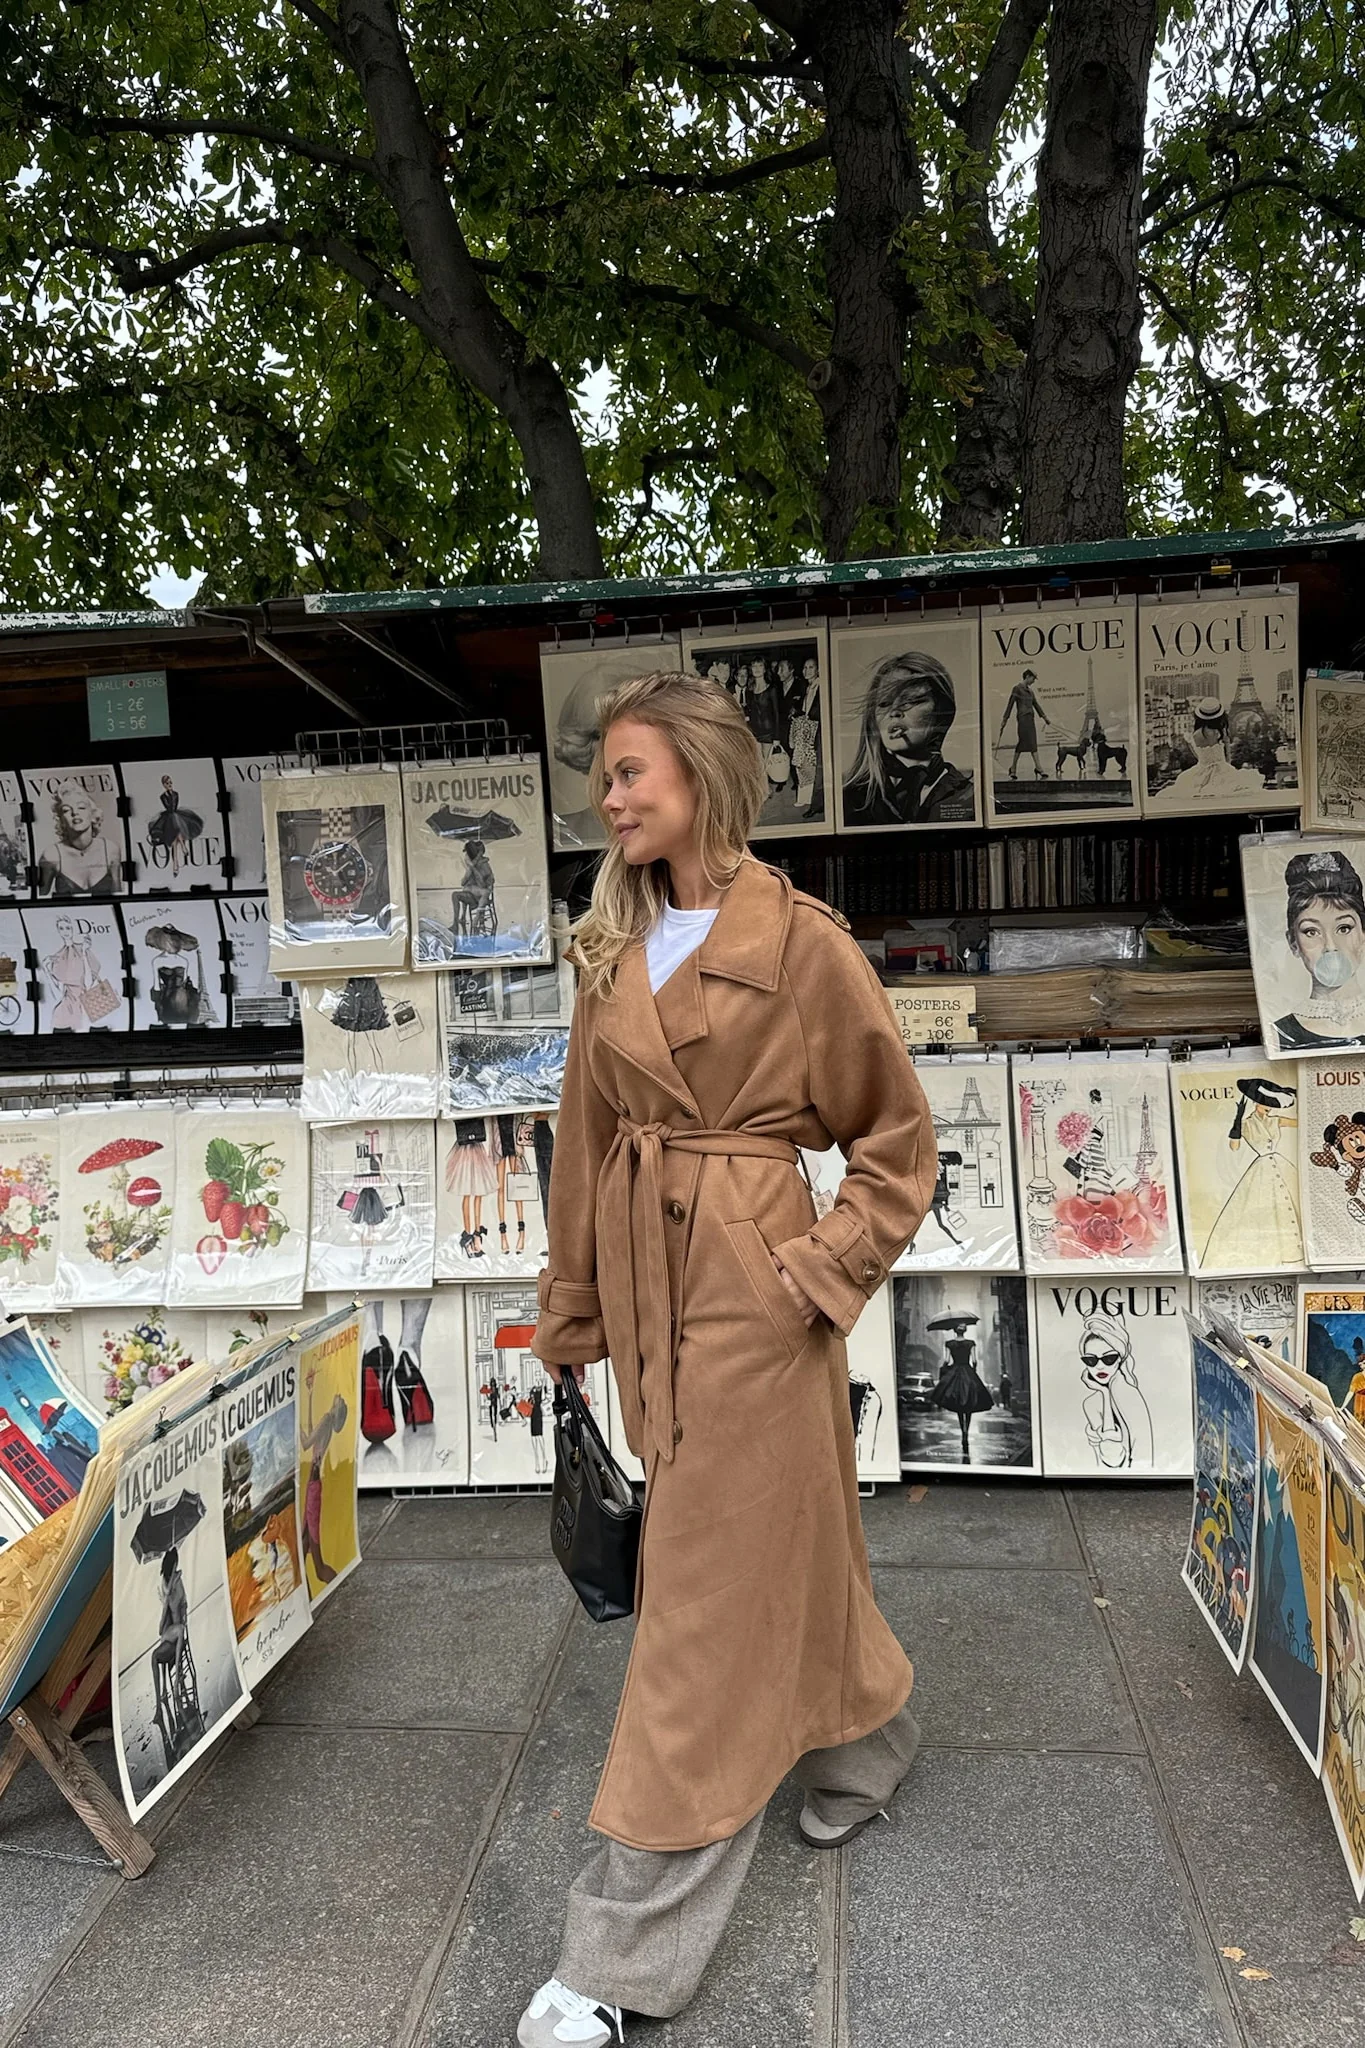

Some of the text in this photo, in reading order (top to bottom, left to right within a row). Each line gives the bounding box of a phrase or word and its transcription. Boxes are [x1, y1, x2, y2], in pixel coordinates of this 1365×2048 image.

[991, 619, 1125, 659] VOGUE
[1150, 614, 1287, 659] VOGUE
[1153, 662, 1179, 673] Paris,
[1180, 662, 1188, 673] je
[90, 677, 165, 693] SMALL POSTERS
[107, 699, 113, 713] 1
[128, 697, 145, 712] 2€
[107, 718, 115, 732] 3
[129, 715, 147, 730] 5€
[28, 774, 114, 797] VOUE
[411, 774, 536, 804] JACQUEMUS
[75, 918, 111, 935] Dior
[461, 1003, 488, 1013] CASTING
[894, 999, 961, 1011] POSTERS
[901, 1016, 908, 1027] 1
[935, 1016, 954, 1027] 6€
[902, 1029, 911, 1039] 2
[927, 1029, 954, 1040] 10€
[1316, 1071, 1361, 1087] LOUIS
[1179, 1086, 1235, 1101] VOGUE
[1049, 1286, 1177, 1317] VOGUE
[1250, 1285, 1271, 1307] VIE
[1324, 1294, 1351, 1311] LES
[120, 1414, 217, 1519] JACQUEMUS
